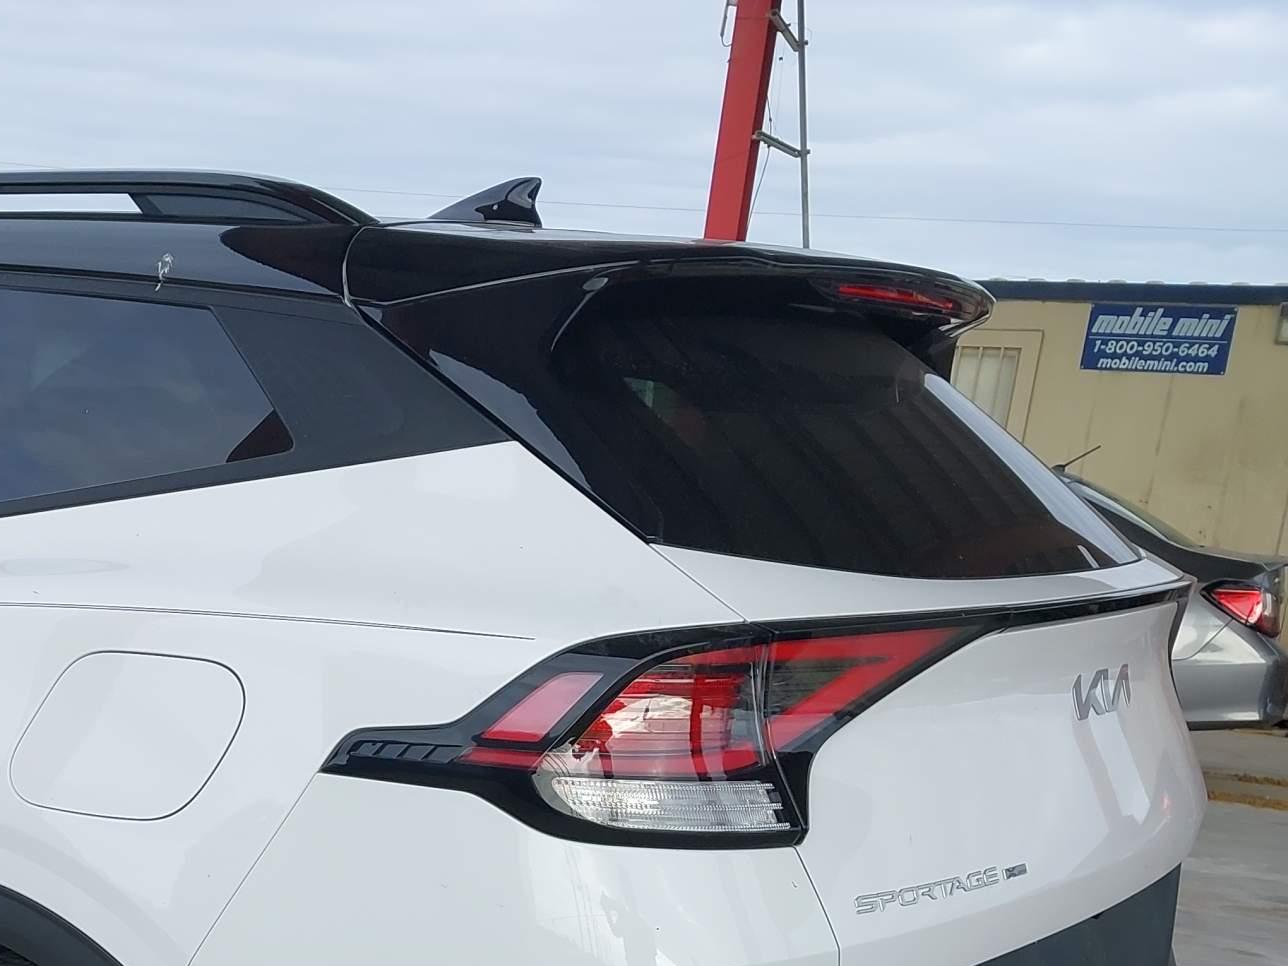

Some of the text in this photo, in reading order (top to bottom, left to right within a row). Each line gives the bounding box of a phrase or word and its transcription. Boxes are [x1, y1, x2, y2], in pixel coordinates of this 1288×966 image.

[1091, 307, 1232, 338] mobile mini
[1093, 339, 1220, 358] 1-800-950-6464
[1097, 356, 1209, 373] mobilemini.com
[1072, 664, 1131, 721] KIA
[854, 865, 1000, 915] SPORTAGE
